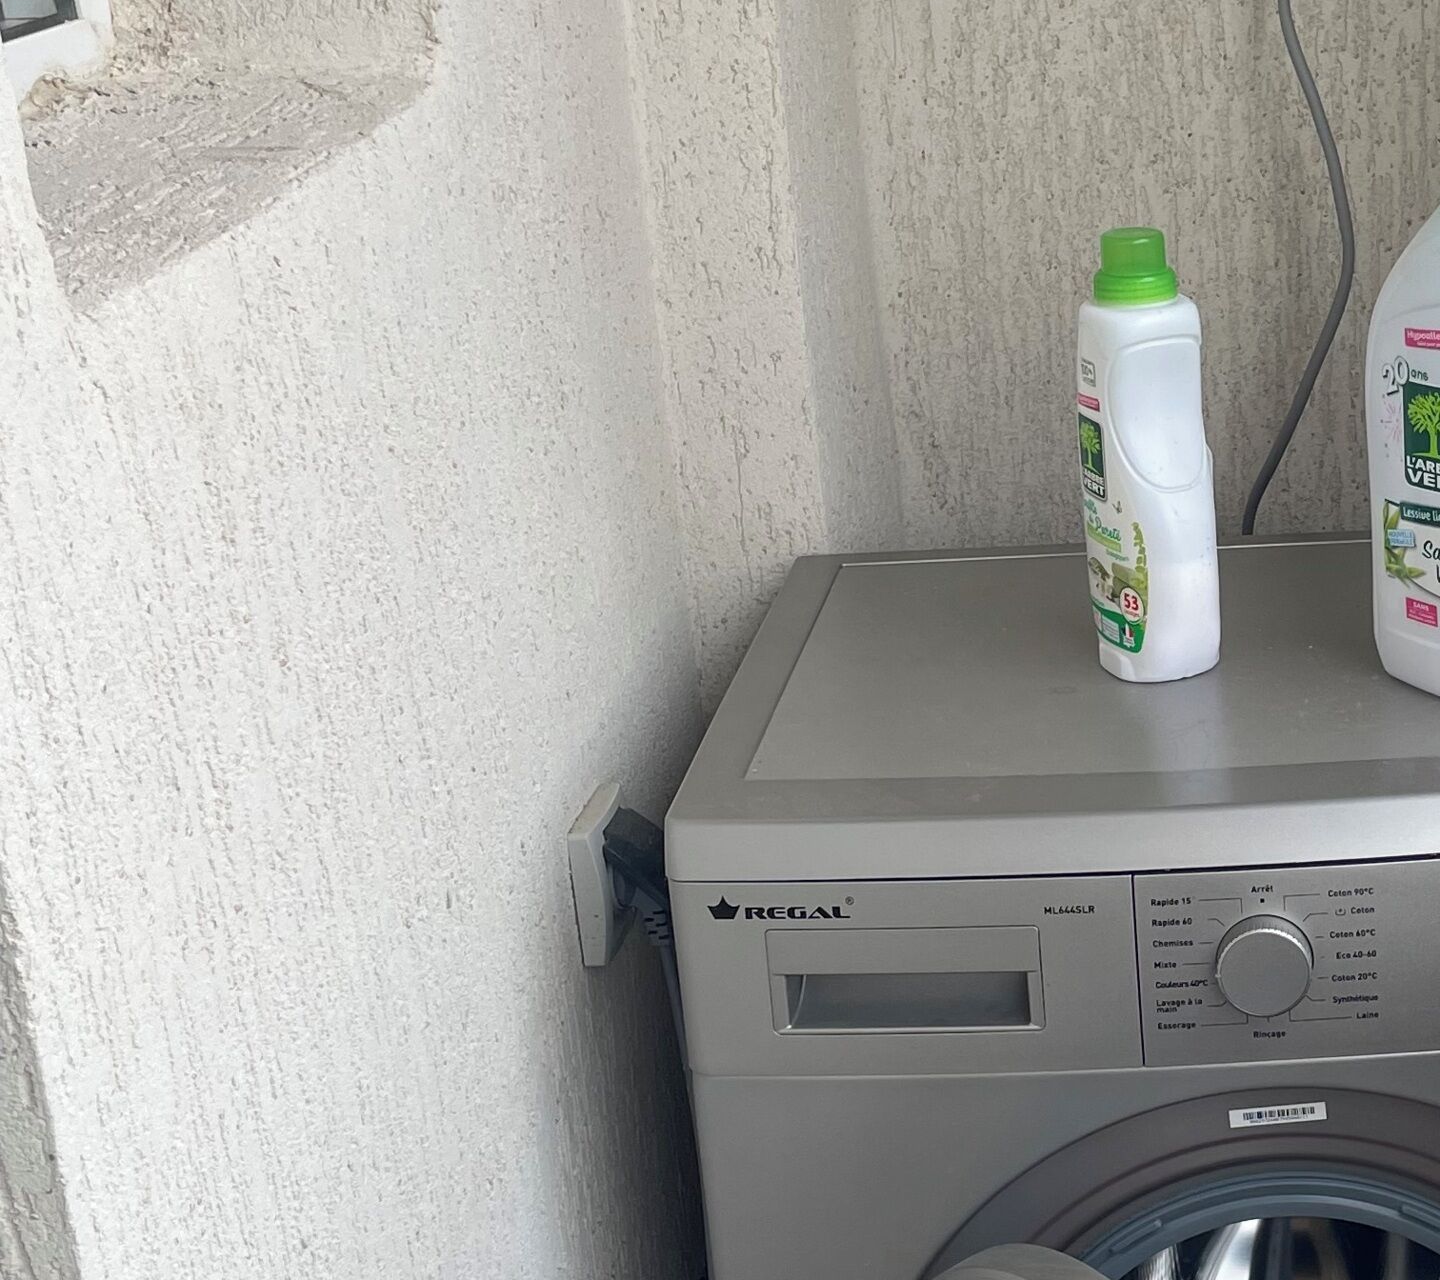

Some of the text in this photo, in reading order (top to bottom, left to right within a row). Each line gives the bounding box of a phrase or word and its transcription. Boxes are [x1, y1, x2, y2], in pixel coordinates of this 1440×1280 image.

[1382, 355, 1429, 397] 20 ans
[1403, 506, 1431, 522] Lessive
[1124, 592, 1139, 611] 53
[1251, 884, 1274, 894] Arrêt
[1328, 888, 1374, 897] Coton 90°C
[1150, 898, 1179, 908] Rapide
[744, 906, 852, 920] REGAL
[1351, 906, 1375, 914] Coton
[1152, 918, 1192, 928] Rapide 60
[1329, 929, 1376, 939] Coton 60°C
[1152, 939, 1194, 948] Chemises
[1336, 951, 1351, 959] Eco
[1154, 961, 1177, 969] Mixte
[1332, 972, 1378, 982] Coton 20°C
[1155, 980, 1189, 989] Couleurs
[1156, 999, 1186, 1009] Lavage
[1332, 994, 1379, 1005] Synthétique
[1356, 1011, 1379, 1019] Laine
[1157, 1021, 1196, 1031] Essorage
[1253, 1030, 1286, 1040] Rinçage
